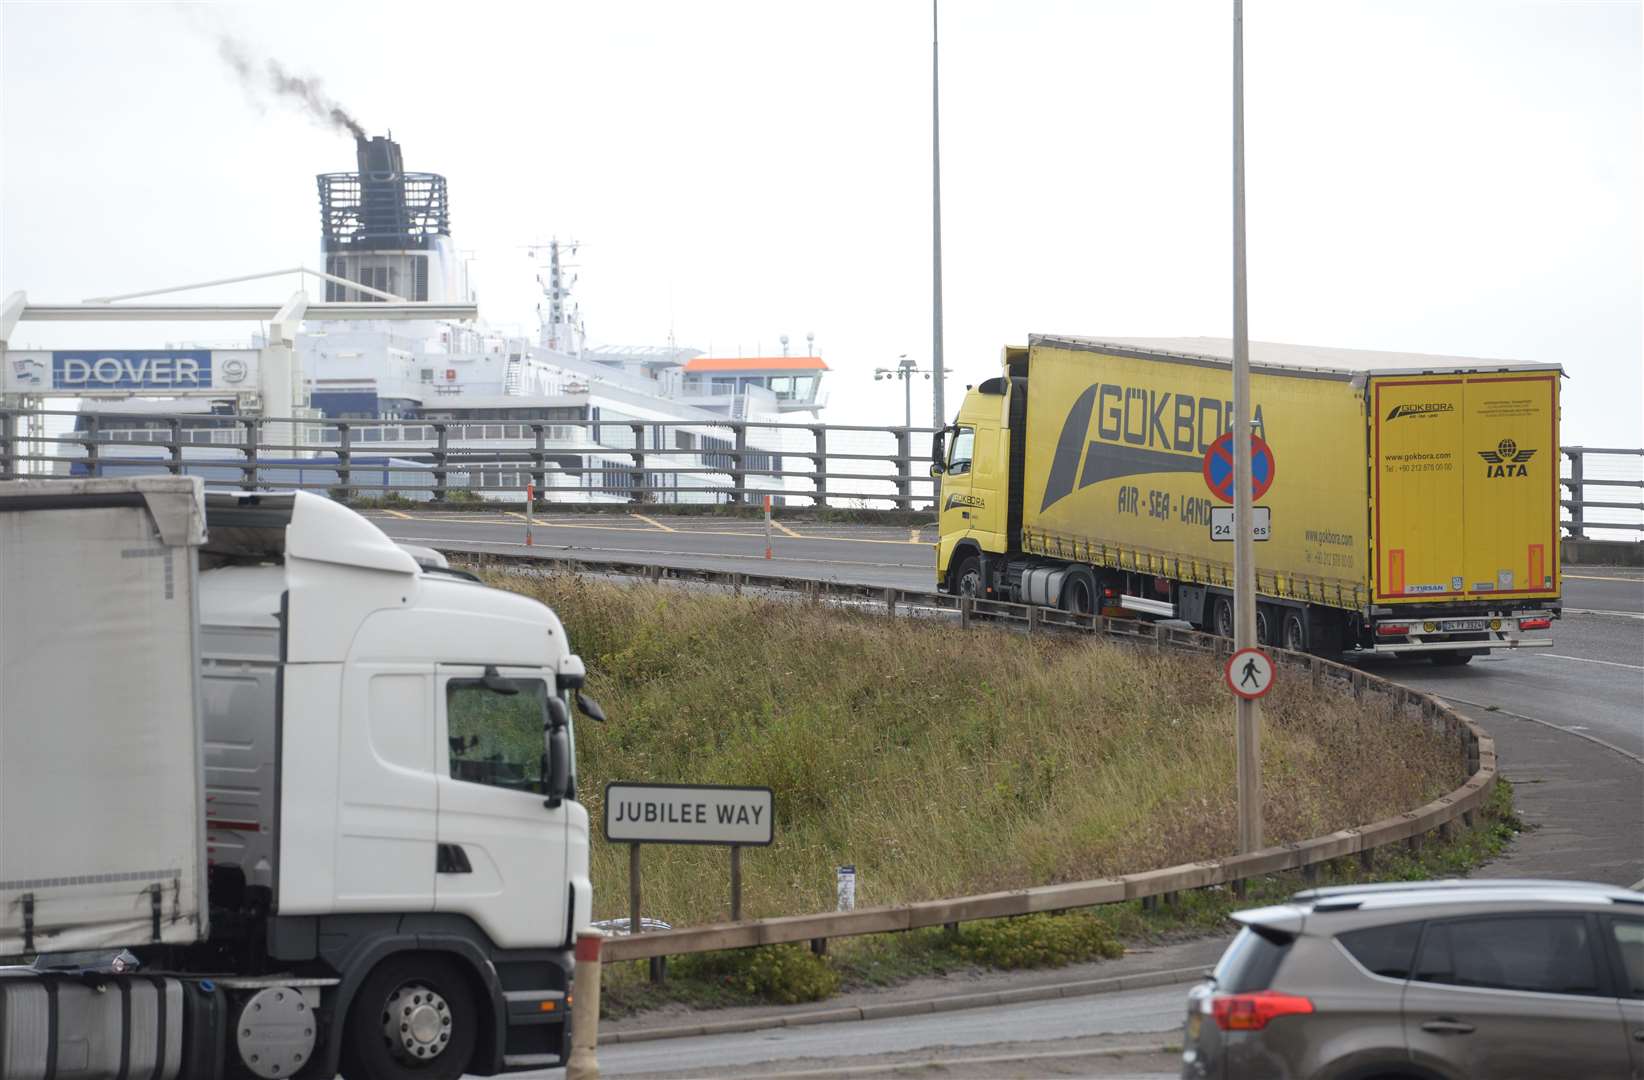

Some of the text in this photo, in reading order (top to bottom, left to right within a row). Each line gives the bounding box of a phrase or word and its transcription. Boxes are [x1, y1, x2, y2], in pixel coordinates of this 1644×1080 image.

[63, 358, 200, 383] DOVER
[1487, 464, 1528, 478] IATA
[1118, 486, 1139, 516] AIR
[1148, 490, 1170, 520] SEA
[1180, 494, 1212, 526] LAND
[1215, 525, 1230, 535] 24
[615, 801, 763, 825] JUBILEE WAY
